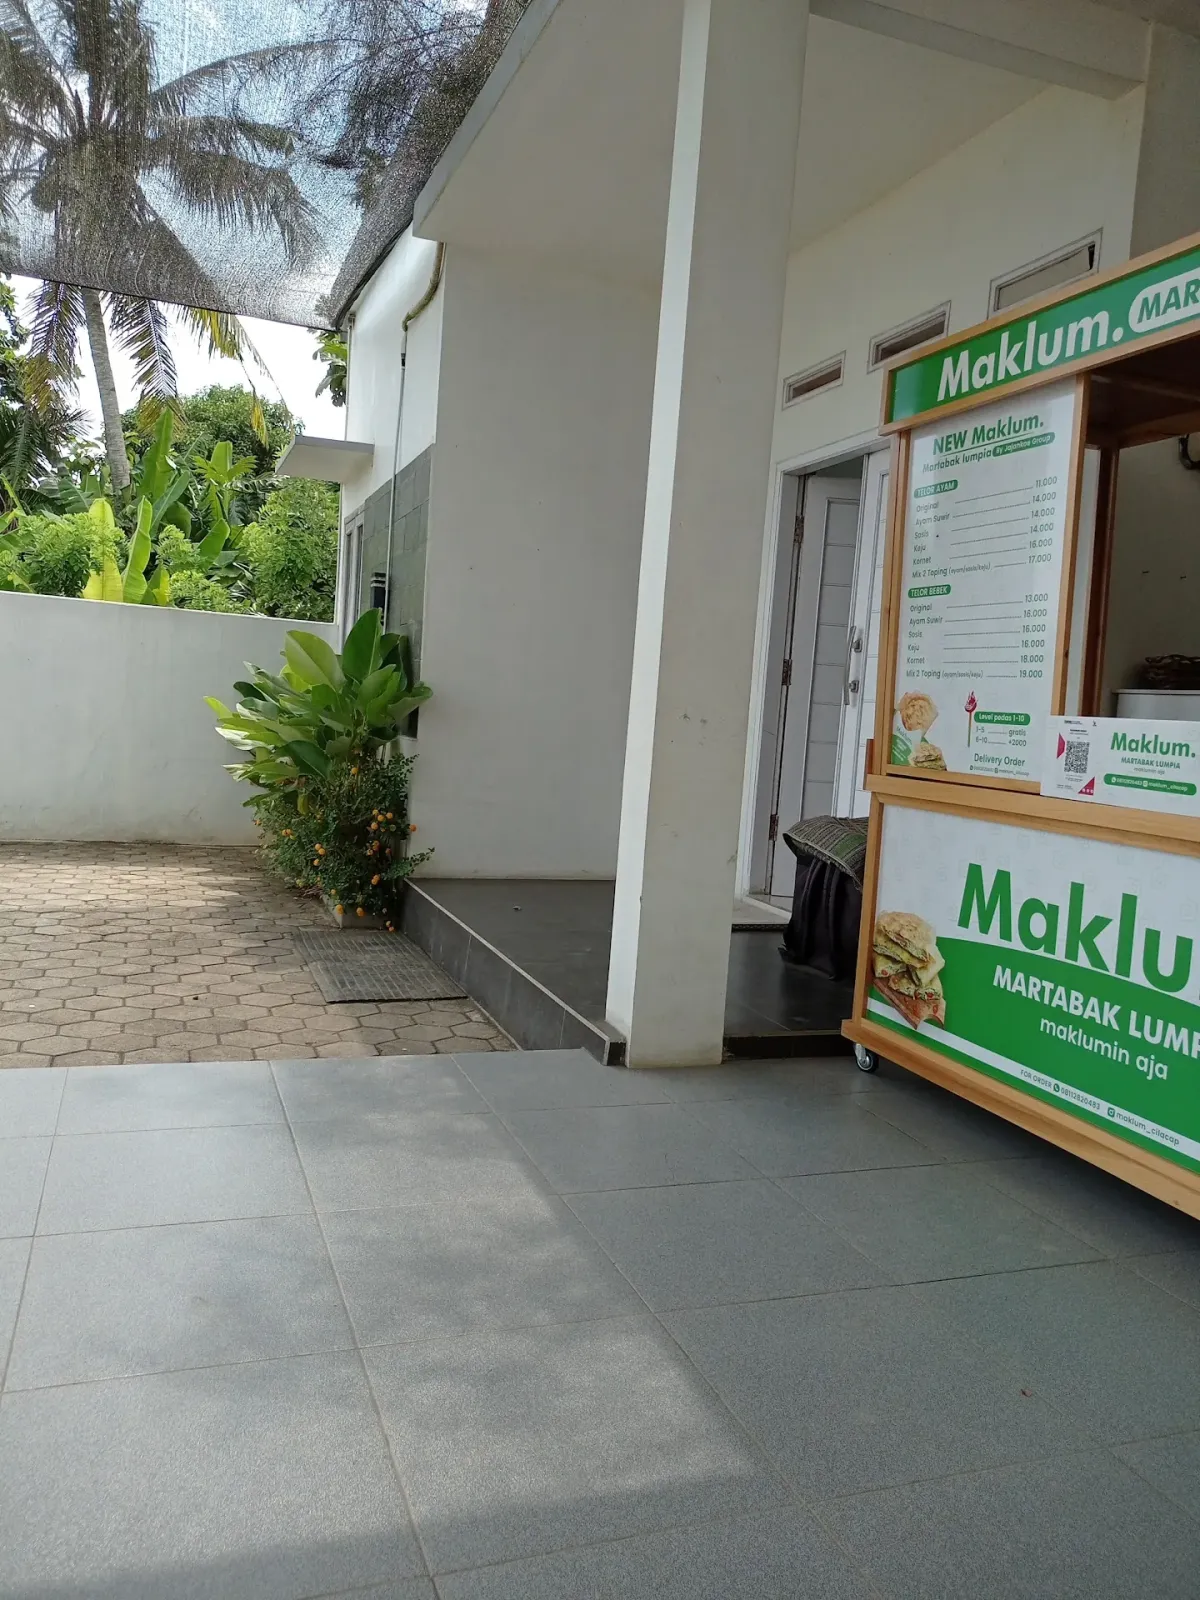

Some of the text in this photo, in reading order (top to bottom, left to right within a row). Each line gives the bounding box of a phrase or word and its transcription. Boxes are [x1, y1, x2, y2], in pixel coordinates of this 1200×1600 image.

[937, 278, 1200, 401] Maklum. MAR
[932, 414, 1044, 455] NEW Maklum.
[1032, 435, 1051, 445] Group
[922, 447, 992, 474] Martabak lumpia
[916, 481, 955, 496] TELOR AYAM
[916, 476, 1057, 513] Original 11.000
[915, 491, 1057, 526] Ayam Suwir 14.000
[914, 507, 1055, 539] Sosis 14.000
[913, 523, 1054, 553] Keju 14.000
[911, 569, 922, 578] Mix
[922, 569, 927, 577] 2
[927, 566, 948, 577] Toping
[1028, 553, 1052, 564] 17.000
[912, 556, 931, 565] Kornet
[911, 585, 948, 597] TELOR BEBEK
[910, 593, 1048, 614] Original 13.000
[909, 618, 926, 627] Ayam
[926, 616, 943, 625] Suwir
[908, 630, 923, 638] Sosis
[907, 643, 920, 652] Keju
[906, 656, 925, 664] Kornet
[921, 669, 941, 679] Toping
[1019, 669, 1043, 678] 19.000
[1013, 714, 1025, 722] 1-10
[1008, 728, 1026, 737] gratis
[1110, 732, 1196, 758] Maklum.
[974, 753, 1025, 767] Delivery Order
[1120, 756, 1181, 769] MARTABAK LUMPIA
[957, 862, 1200, 1000] Maklu
[993, 964, 1121, 1031] MARTABAK
[1040, 1018, 1168, 1080] maklumin aja
[1021, 1069, 1032, 1079] FOR
[1033, 1075, 1052, 1089] ORDER
[1116, 1111, 1179, 1146] maklum_cilacap
